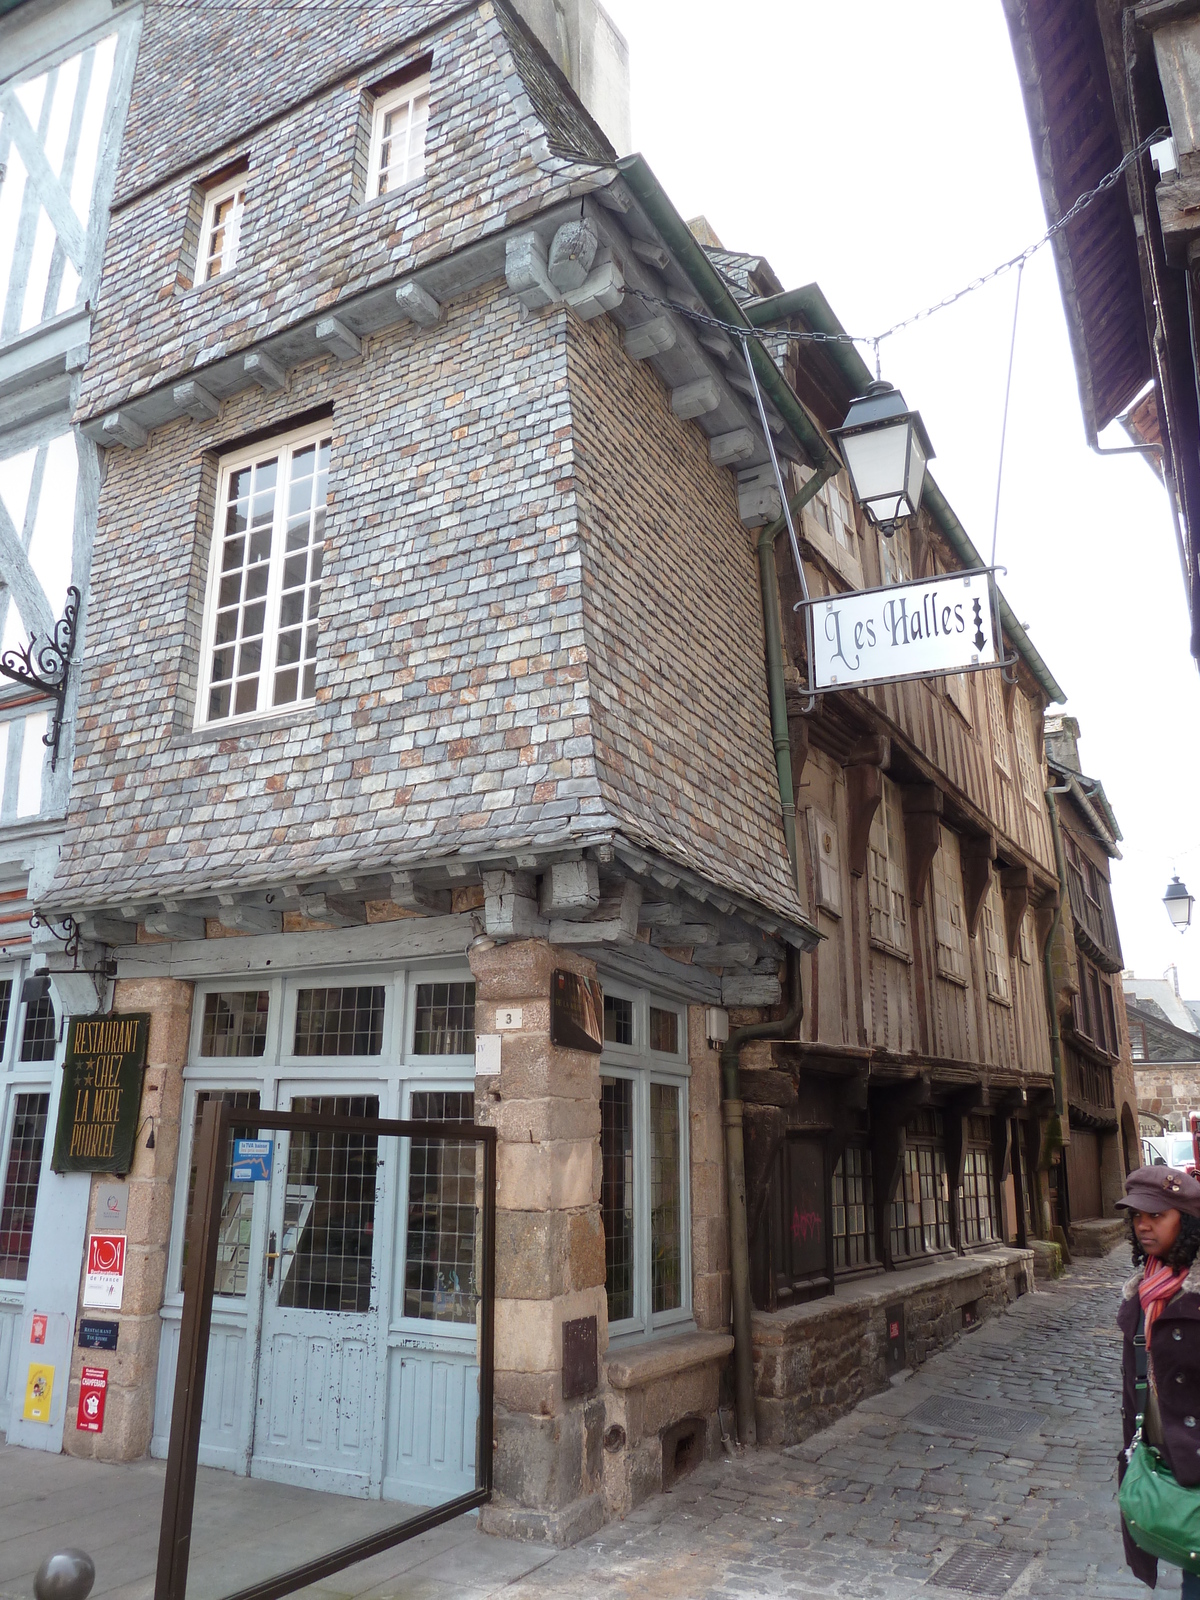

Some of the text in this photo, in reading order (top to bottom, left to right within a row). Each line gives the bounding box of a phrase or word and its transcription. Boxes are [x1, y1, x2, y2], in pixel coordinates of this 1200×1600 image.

[824, 592, 965, 670] Les Halles
[505, 1013, 513, 1025] 3
[73, 1020, 140, 1054] RESTAURANT
[94, 1054, 123, 1087] CHEZ
[74, 1088, 124, 1122] LA MERE
[69, 1124, 116, 1157] POURCEL
